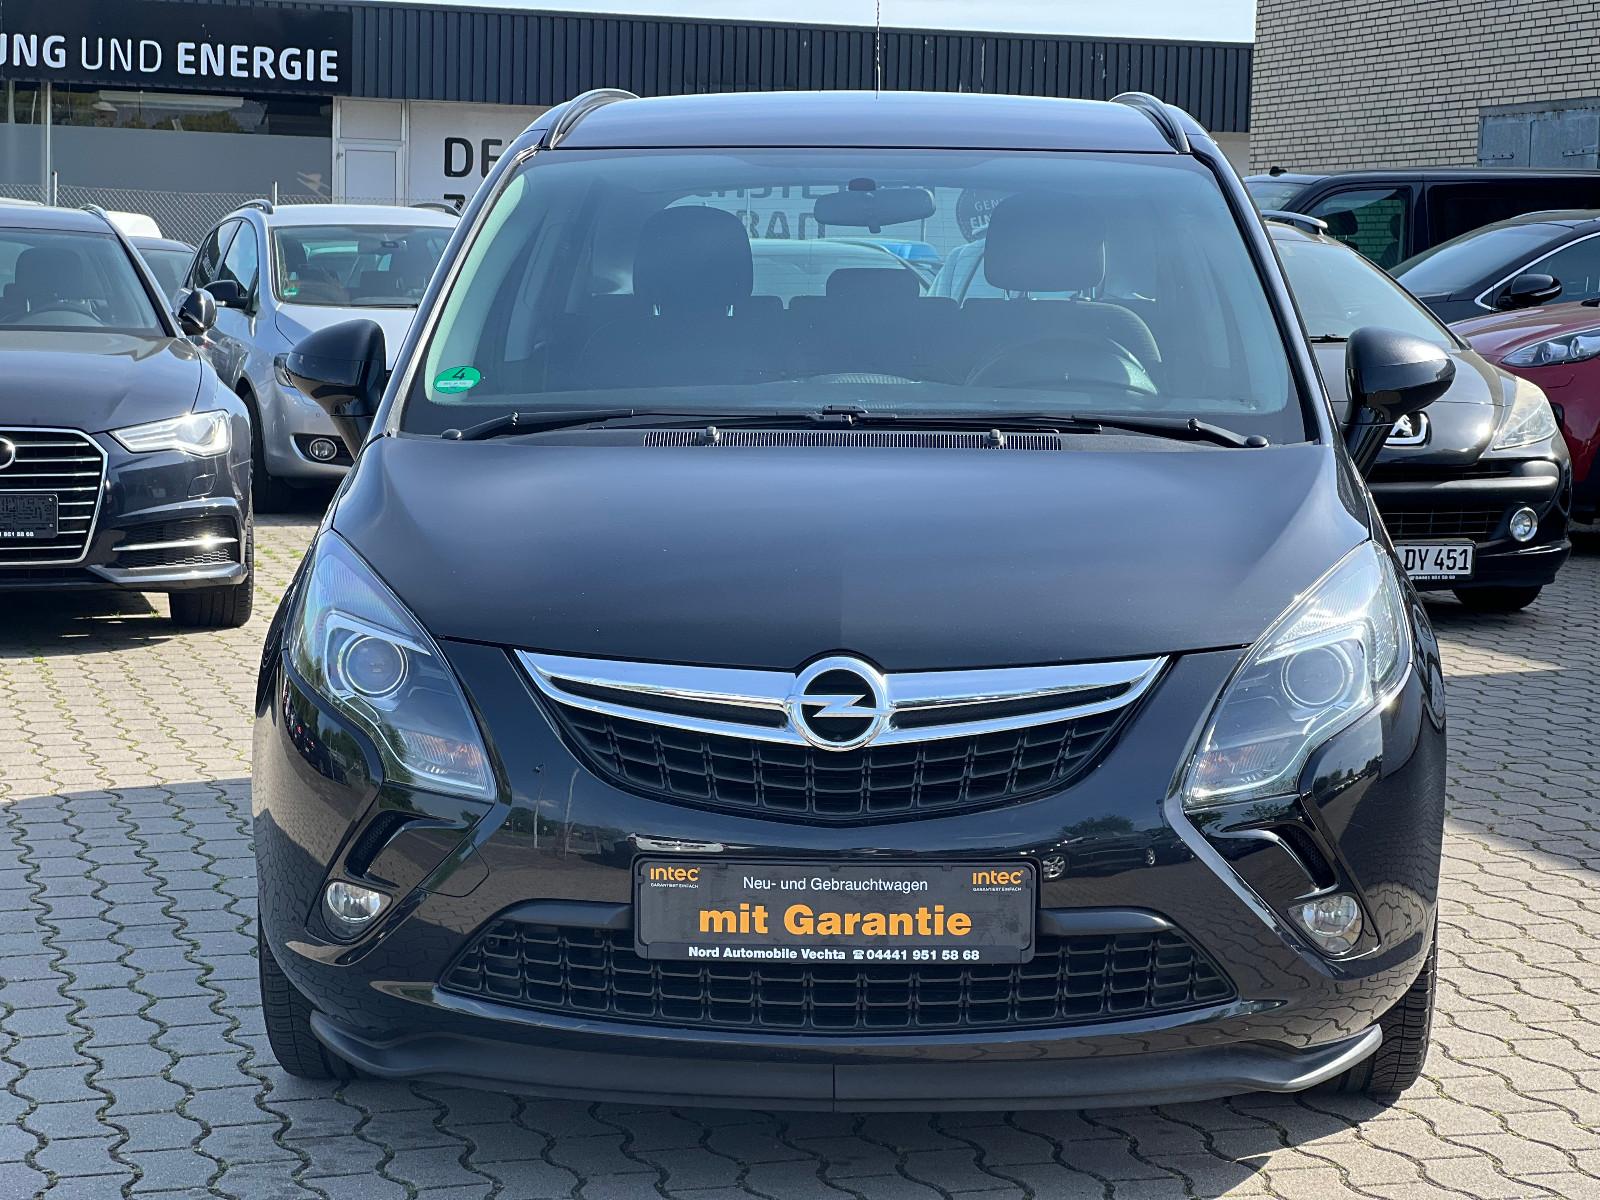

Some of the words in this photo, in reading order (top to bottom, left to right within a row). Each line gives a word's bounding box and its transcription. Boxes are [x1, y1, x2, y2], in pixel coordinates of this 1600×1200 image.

[82, 37, 162, 73] UND
[177, 42, 338, 83] ENERGIE
[452, 367, 466, 380] 4
[1404, 548, 1429, 571] DY
[1433, 548, 1469, 571] 451
[650, 866, 699, 881] intec
[972, 870, 1022, 885] intec
[743, 876, 777, 890] Neu-
[780, 877, 807, 891] und
[810, 878, 929, 894] Gebrauchtwagen
[699, 903, 769, 934] mit
[783, 904, 972, 936] Garantie
[688, 946, 720, 958] Nord
[723, 947, 798, 960] Automobile
[801, 948, 846, 960] Vechta
[866, 949, 907, 961] 04441
[912, 949, 937, 961] 951
[941, 949, 959, 961] 58
[962, 949, 980, 961] 68
